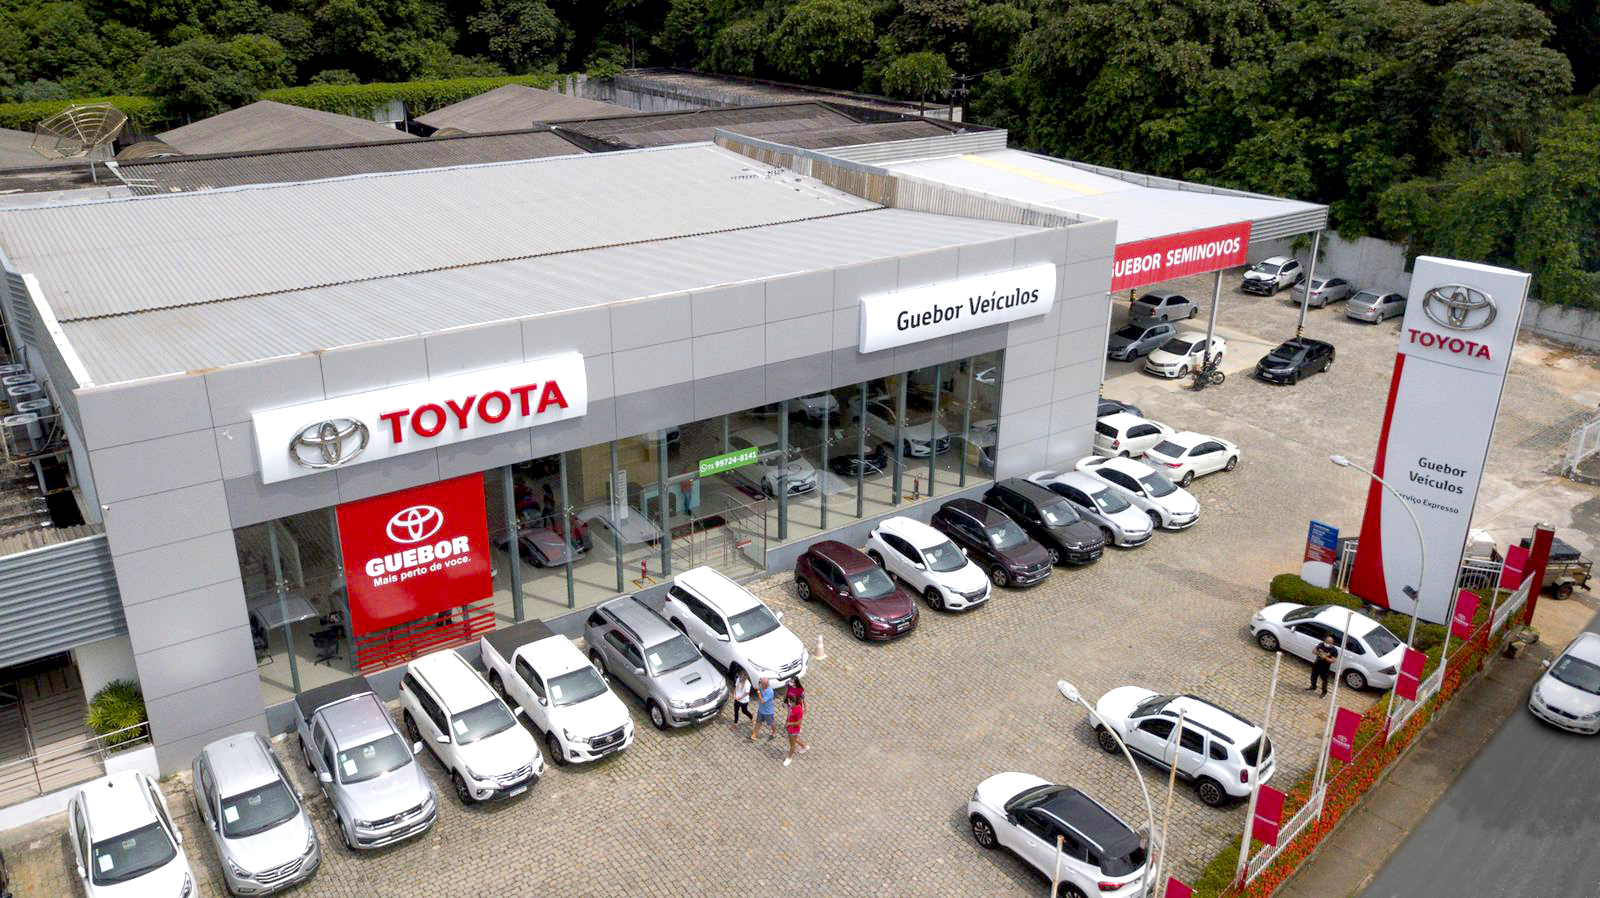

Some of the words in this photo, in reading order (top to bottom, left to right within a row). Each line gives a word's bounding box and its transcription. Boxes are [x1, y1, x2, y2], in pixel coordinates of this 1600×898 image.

[1112, 253, 1161, 278] UEBOR
[1165, 237, 1241, 267] SEMINOVOS
[896, 304, 964, 331] Guebor
[968, 288, 1039, 316] Veículos
[1408, 328, 1491, 361] TOYOTA
[379, 379, 569, 444] TOYOTA
[714, 451, 757, 468] 99724-8141
[1418, 457, 1468, 477] Guebor
[1409, 470, 1464, 494] Veículos
[1422, 498, 1459, 514] Expresso
[365, 535, 470, 577] GUEBOR
[373, 574, 398, 587] Mais
[400, 565, 427, 581] perto
[429, 562, 442, 572] de
